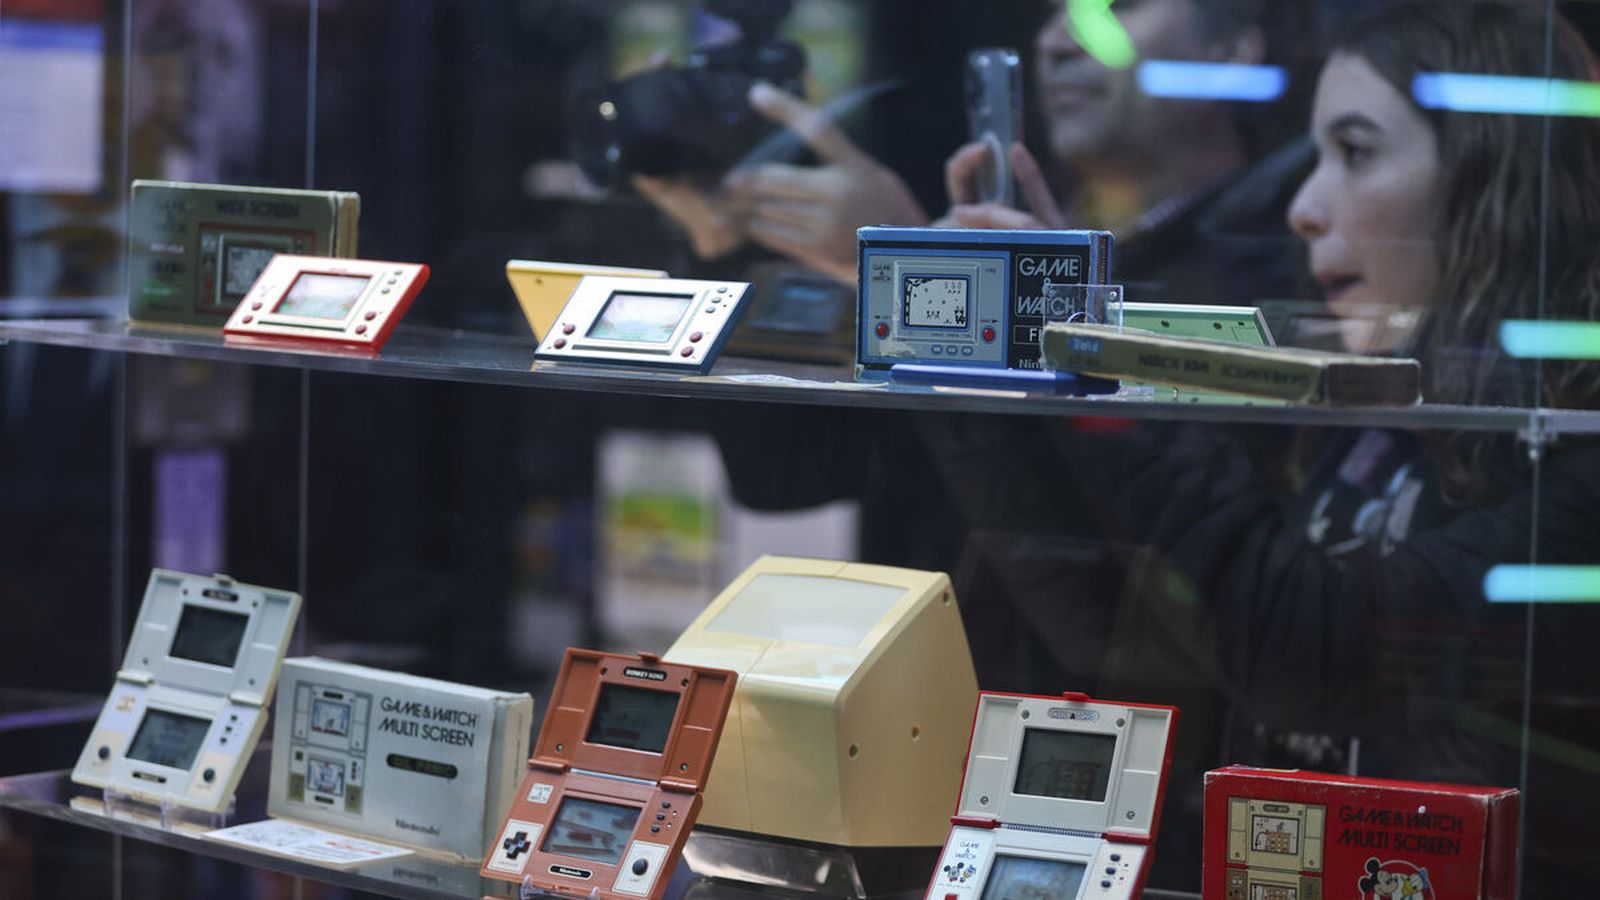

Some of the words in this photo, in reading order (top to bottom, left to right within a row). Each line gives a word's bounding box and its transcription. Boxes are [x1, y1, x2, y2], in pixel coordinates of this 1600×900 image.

[1019, 257, 1079, 278] GAME
[1017, 296, 1075, 316] WATCH
[1029, 328, 1043, 342] FI
[380, 697, 422, 718] GAME
[423, 706, 431, 719] &
[433, 706, 477, 727] WATCH
[378, 717, 418, 737] MULTI
[423, 723, 475, 748] SCREEN
[1339, 806, 1393, 825] GAME
[1405, 811, 1463, 832] WATCH
[1336, 830, 1390, 849] MULTI
[1394, 835, 1461, 855] SCREEN
